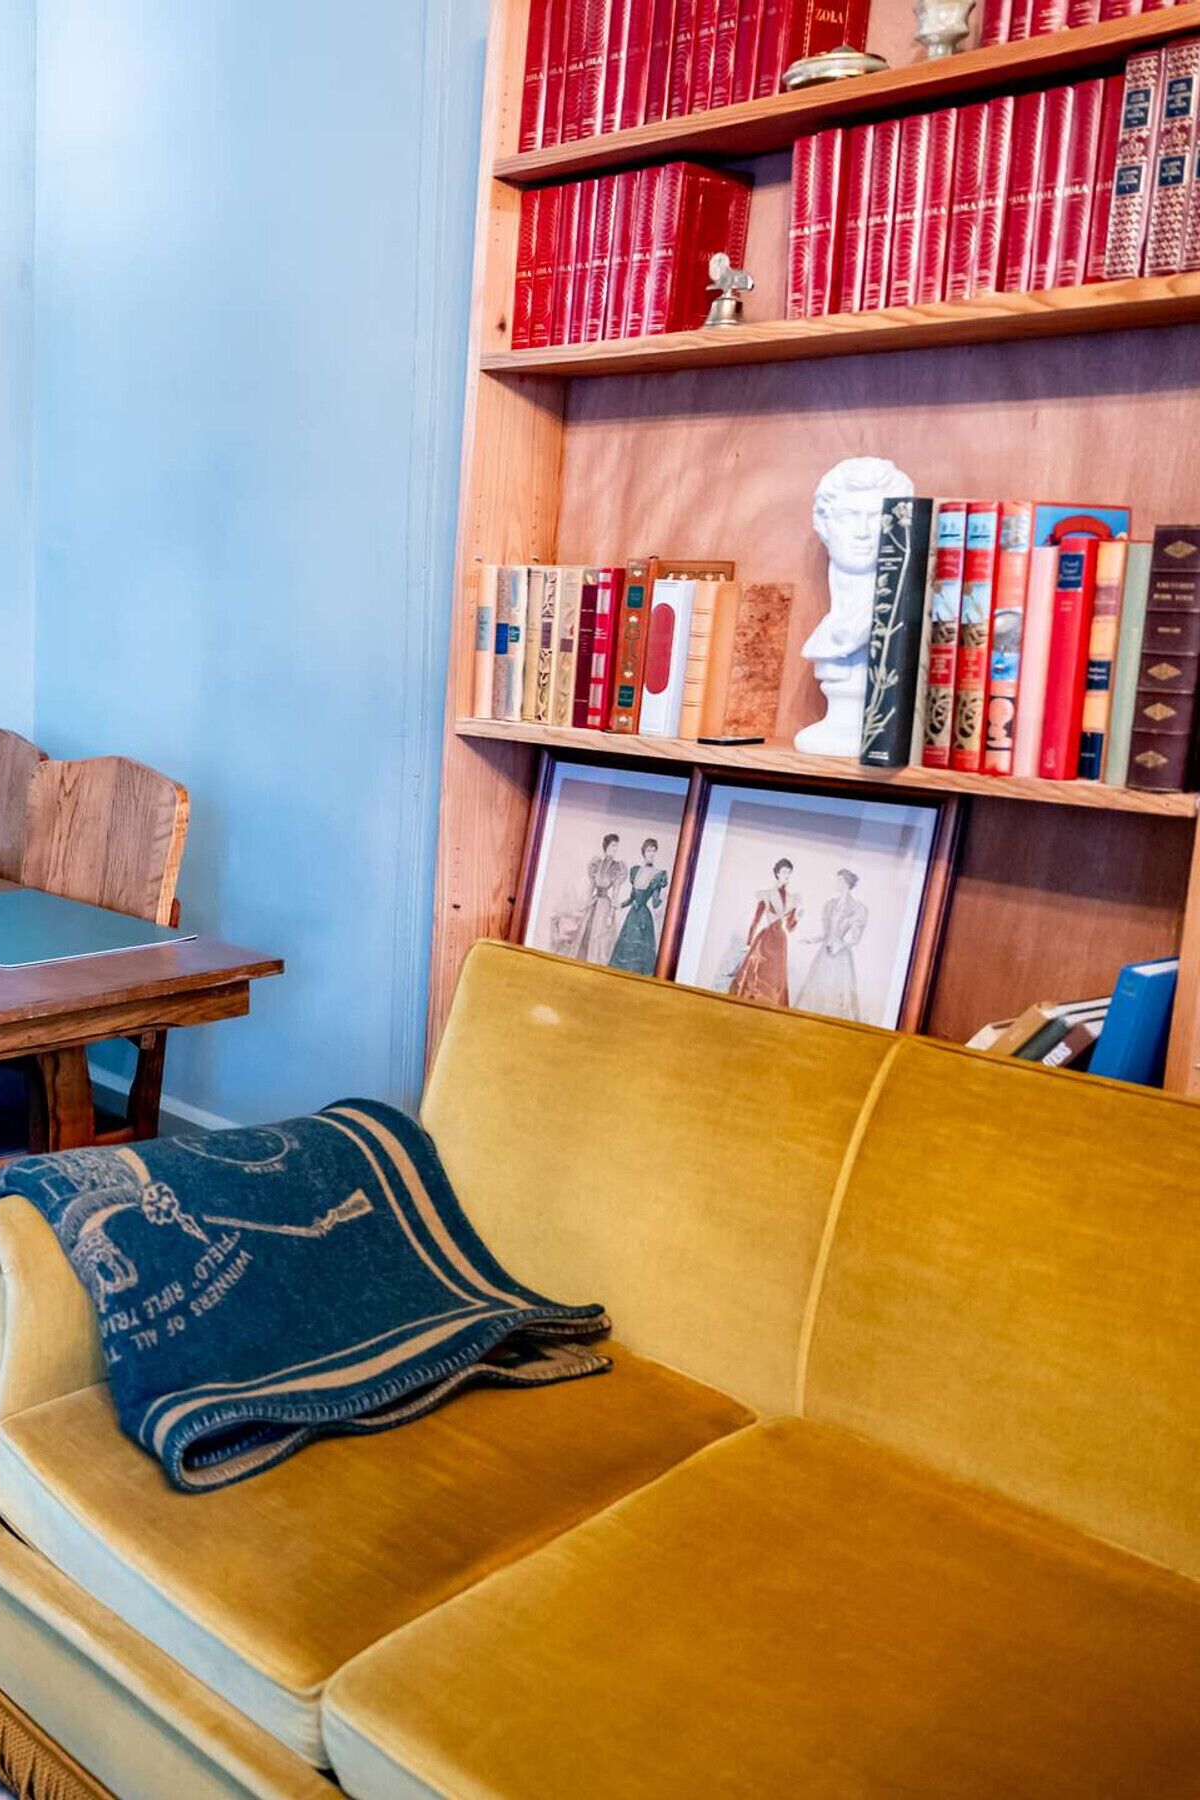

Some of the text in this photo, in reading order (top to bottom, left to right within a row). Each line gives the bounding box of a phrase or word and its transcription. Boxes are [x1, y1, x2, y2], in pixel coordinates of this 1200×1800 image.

[815, 8, 844, 24] ZOLA
[189, 1249, 254, 1318] WINNERS
[142, 1280, 185, 1319] RIFLE
[166, 1315, 186, 1338] OF
[129, 1328, 158, 1351] ALL
